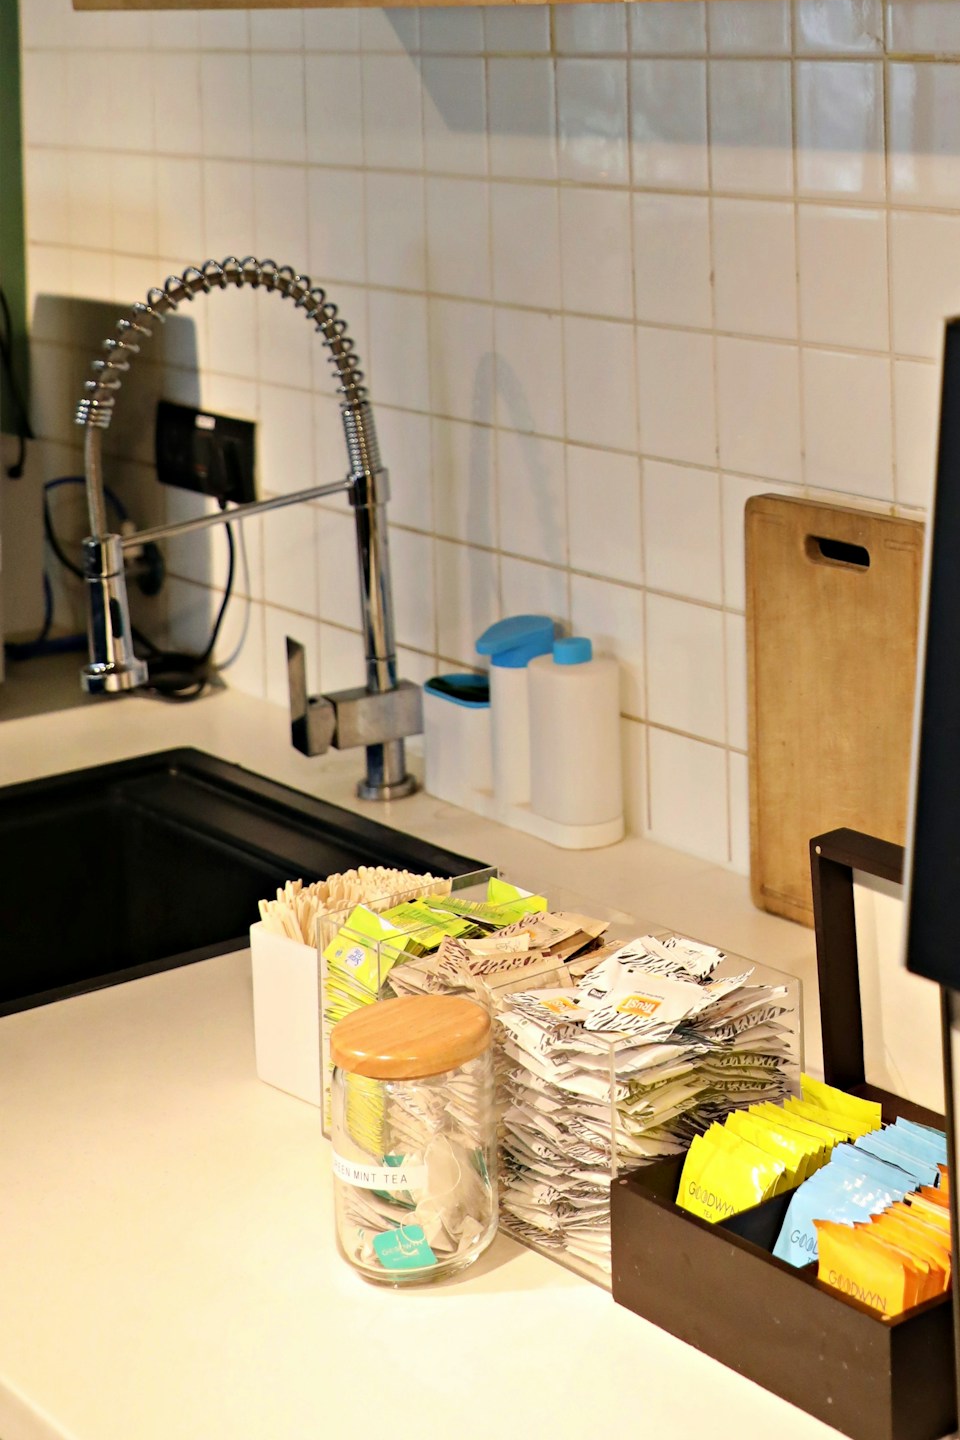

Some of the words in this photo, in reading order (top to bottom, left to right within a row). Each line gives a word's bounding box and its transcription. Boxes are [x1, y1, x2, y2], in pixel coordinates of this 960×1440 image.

[353, 1169, 377, 1184] MINT
[383, 1173, 408, 1185] TEA
[828, 1269, 888, 1311] GOODWYN
